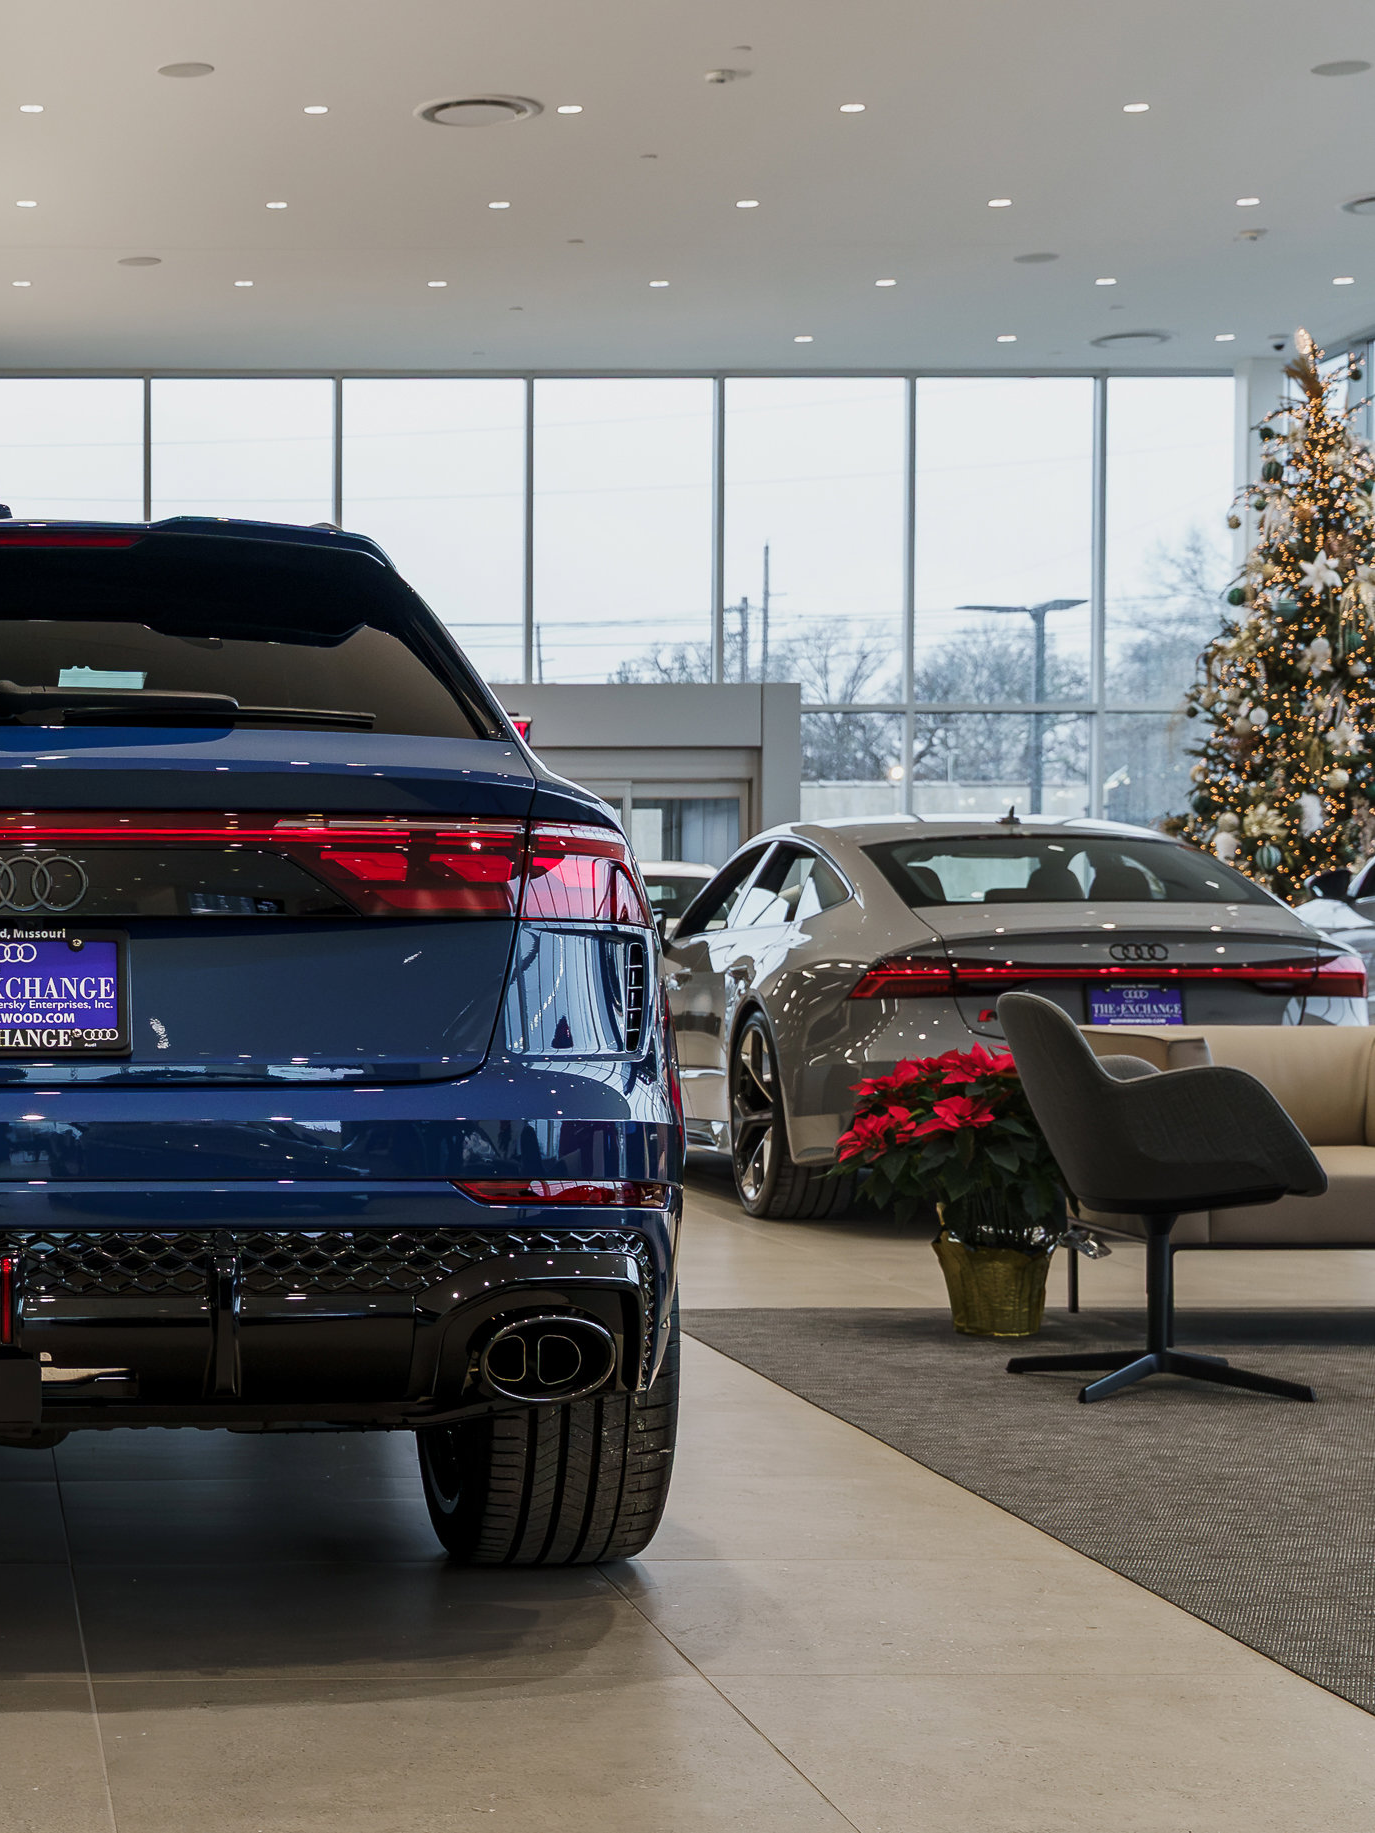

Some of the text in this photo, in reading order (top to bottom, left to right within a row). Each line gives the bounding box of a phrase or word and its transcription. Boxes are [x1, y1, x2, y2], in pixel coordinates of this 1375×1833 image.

[13, 928, 66, 939] Missouri
[29, 1000, 92, 1011] Enterprises,
[94, 1000, 114, 1009] Inc.
